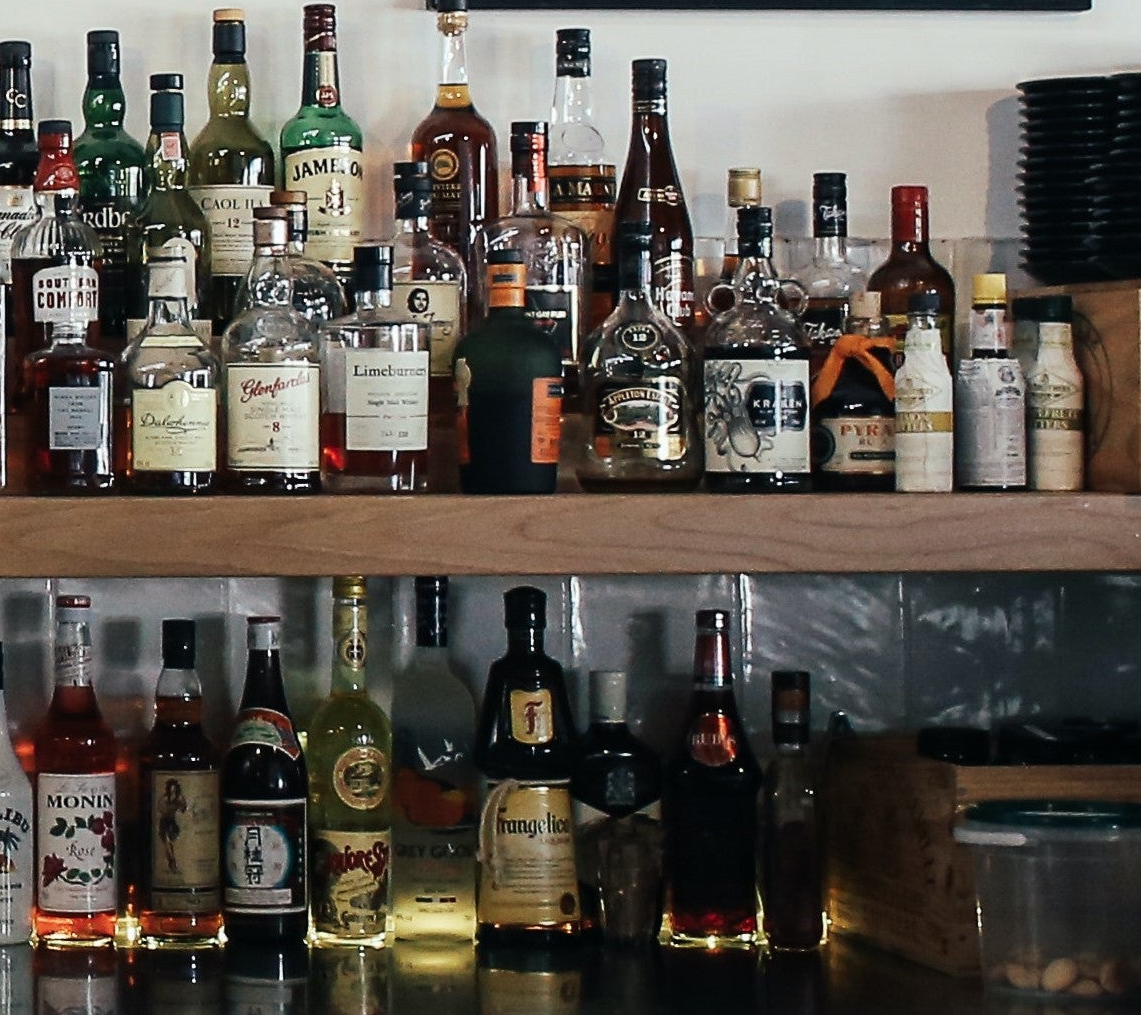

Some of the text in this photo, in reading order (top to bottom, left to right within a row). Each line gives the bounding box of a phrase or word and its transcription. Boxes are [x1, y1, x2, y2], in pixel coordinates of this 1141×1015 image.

[201, 197, 240, 210] CAOL
[227, 218, 240, 228] 12
[272, 421, 280, 432] 8
[47, 793, 113, 809] MONIN
